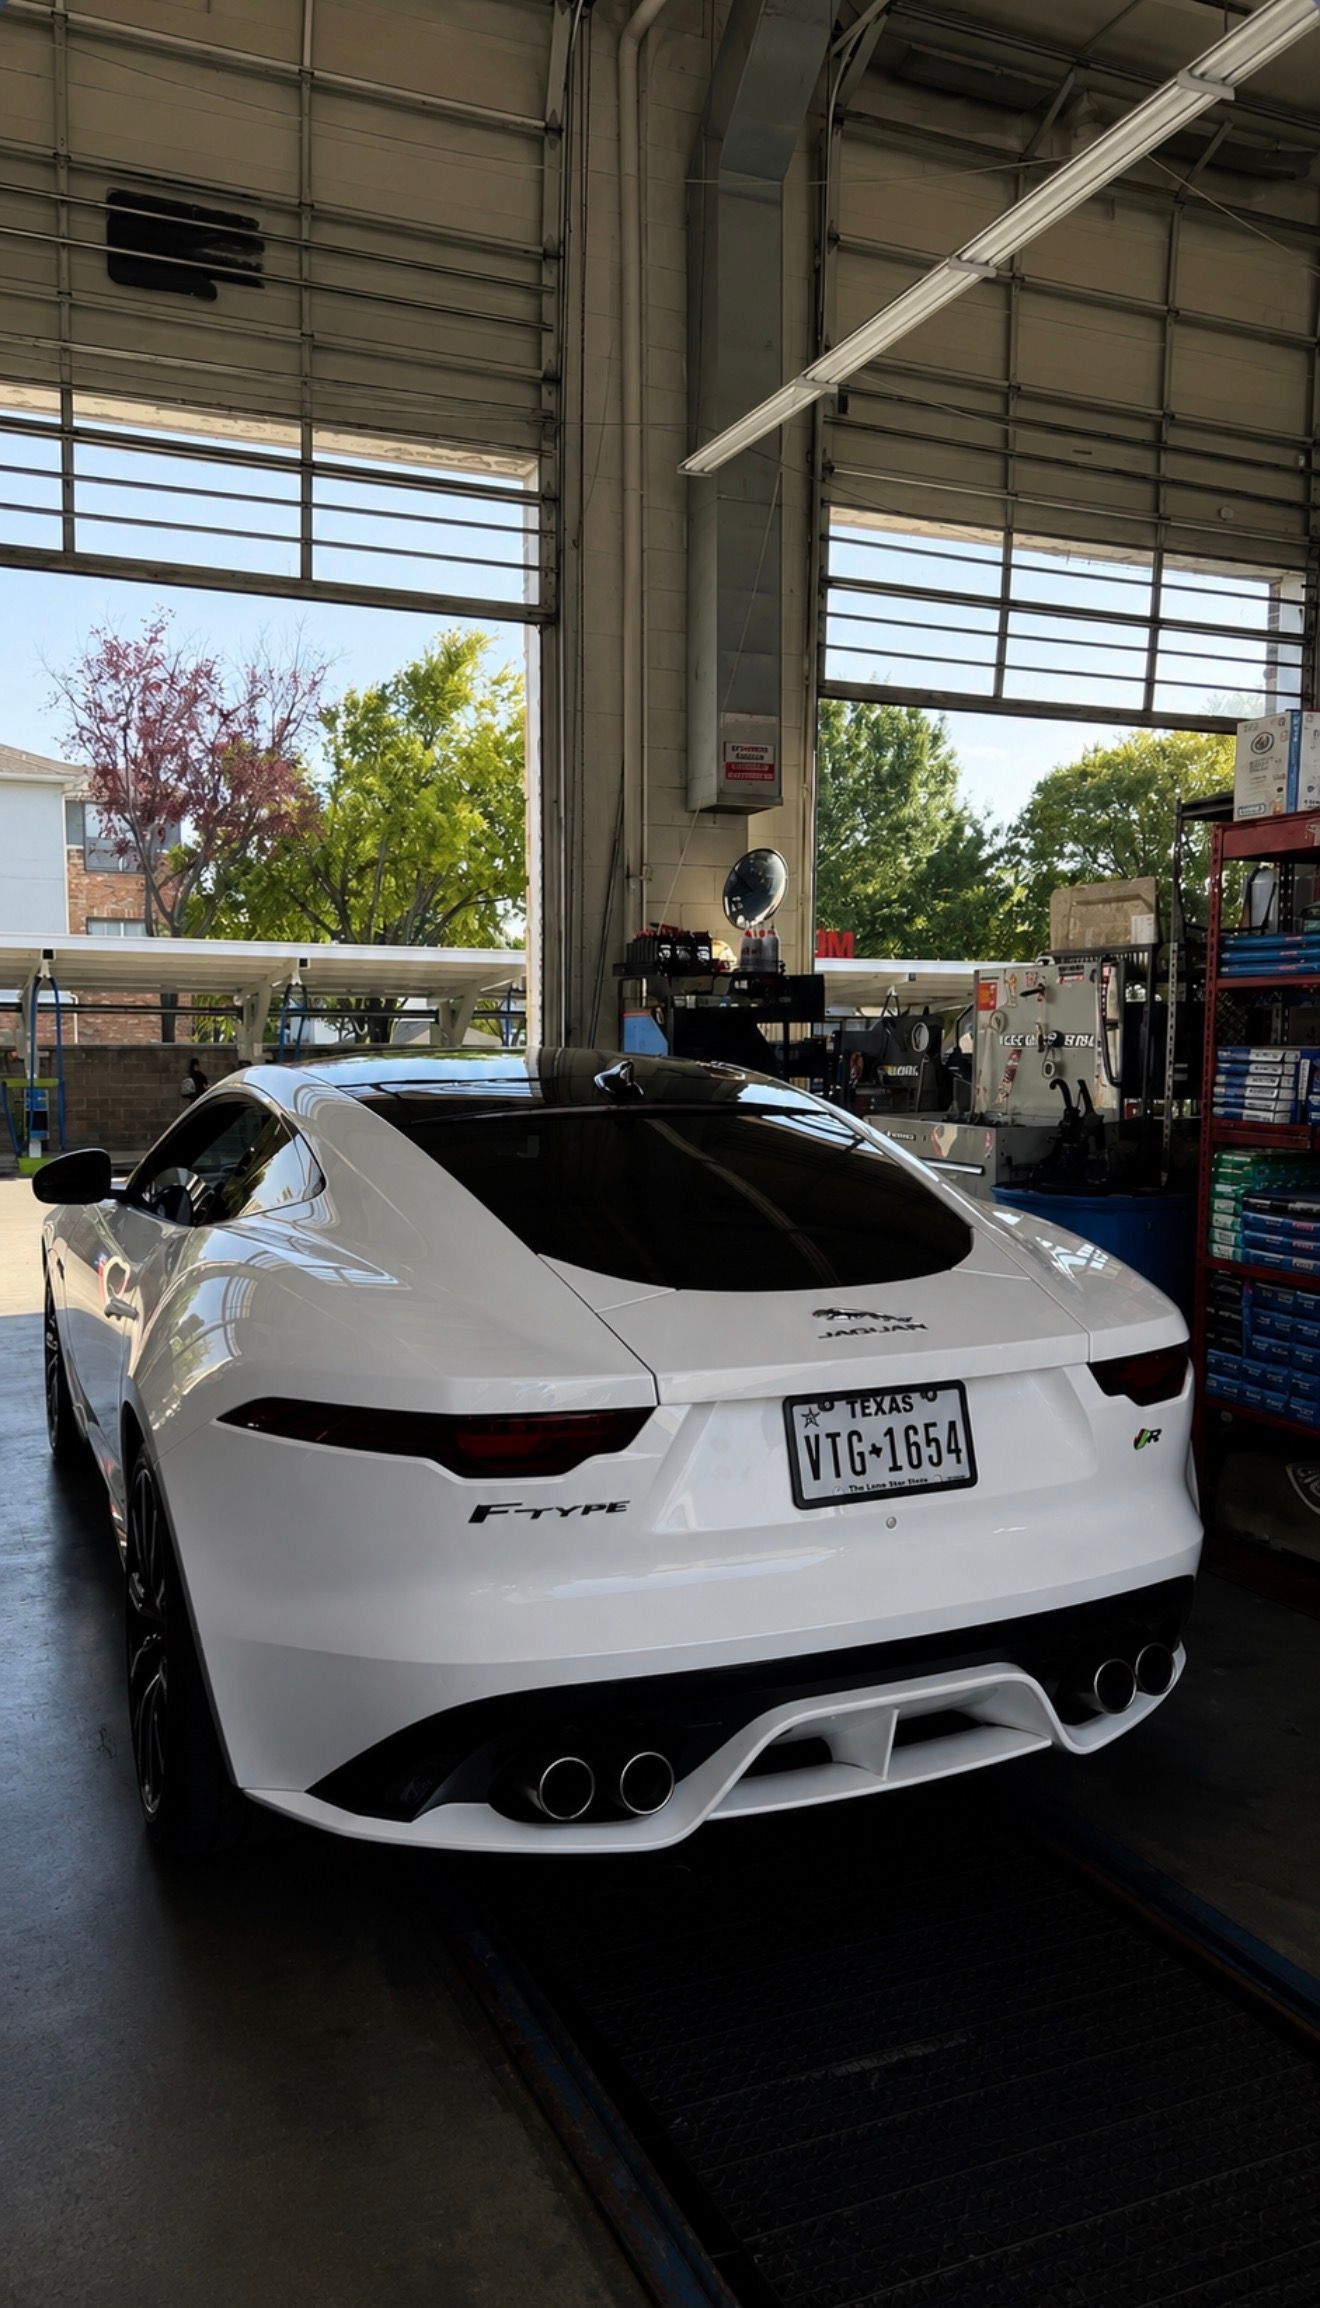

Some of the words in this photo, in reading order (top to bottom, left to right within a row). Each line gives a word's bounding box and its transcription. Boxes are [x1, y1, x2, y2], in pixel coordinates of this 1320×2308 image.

[817, 1323, 928, 1339] JAGUAR
[846, 1395, 914, 1419] TEXAS
[804, 1429, 867, 1481] VTG
[883, 1420, 963, 1473] 1654
[467, 1499, 631, 1524] F-TYPE
